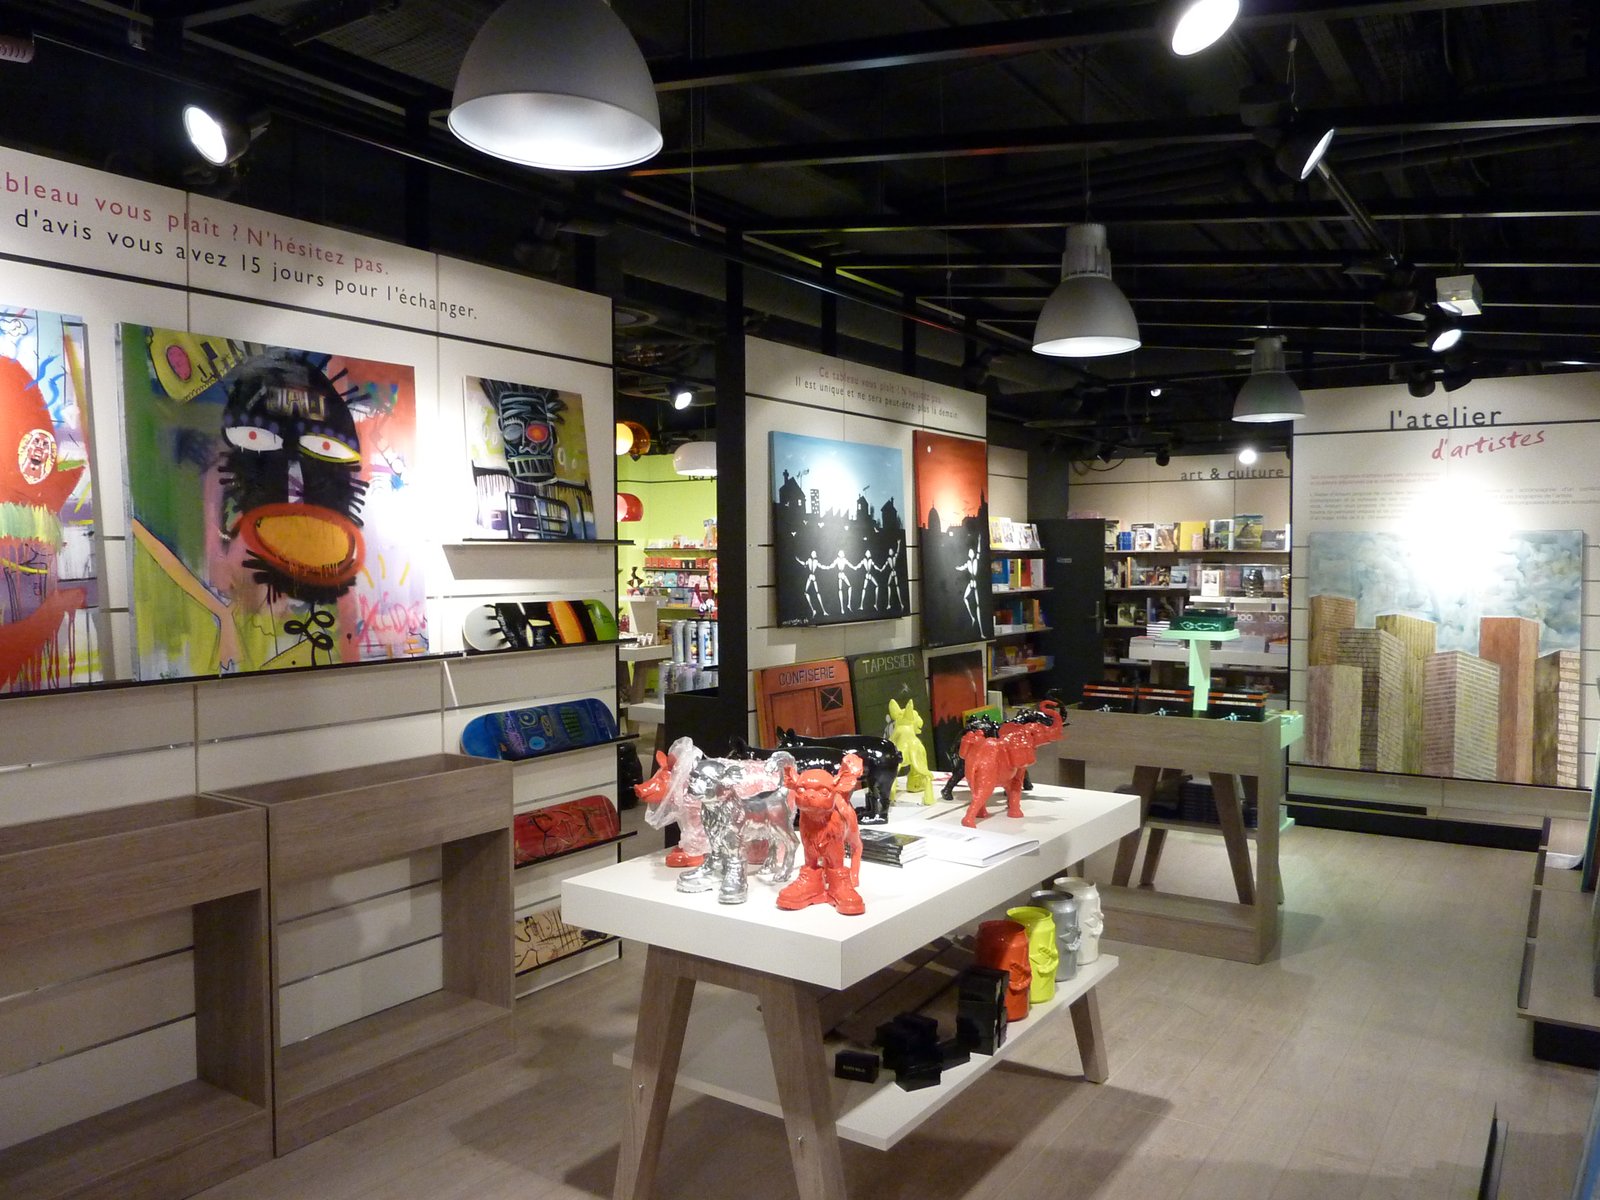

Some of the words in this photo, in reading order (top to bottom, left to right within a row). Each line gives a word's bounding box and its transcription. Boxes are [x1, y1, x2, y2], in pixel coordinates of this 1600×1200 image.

[0, 172, 79, 206] bleau
[95, 198, 152, 222] vous
[168, 212, 220, 238] plaît
[232, 224, 239, 241] ?
[247, 227, 344, 265] N'hésitez
[354, 257, 389, 275] pas.
[15, 208, 92, 241] d'avis
[107, 232, 163, 255] vous
[176, 246, 227, 268] avez
[242, 254, 261, 274] 15
[273, 262, 324, 288] jours
[335, 279, 378, 295] pour
[387, 285, 478, 319] l'échanger.
[795, 376, 801, 387] Il
[804, 380, 816, 391] est
[820, 384, 844, 397] unique
[847, 389, 854, 398] et
[1390, 406, 1502, 431] l'atelier
[1431, 430, 1545, 460] d'artistes
[1180, 471, 1203, 481] art
[1210, 467, 1221, 480] &
[1227, 467, 1285, 480] culture
[862, 653, 916, 674] TAPISSIER
[779, 665, 835, 687] CONFISERIE
